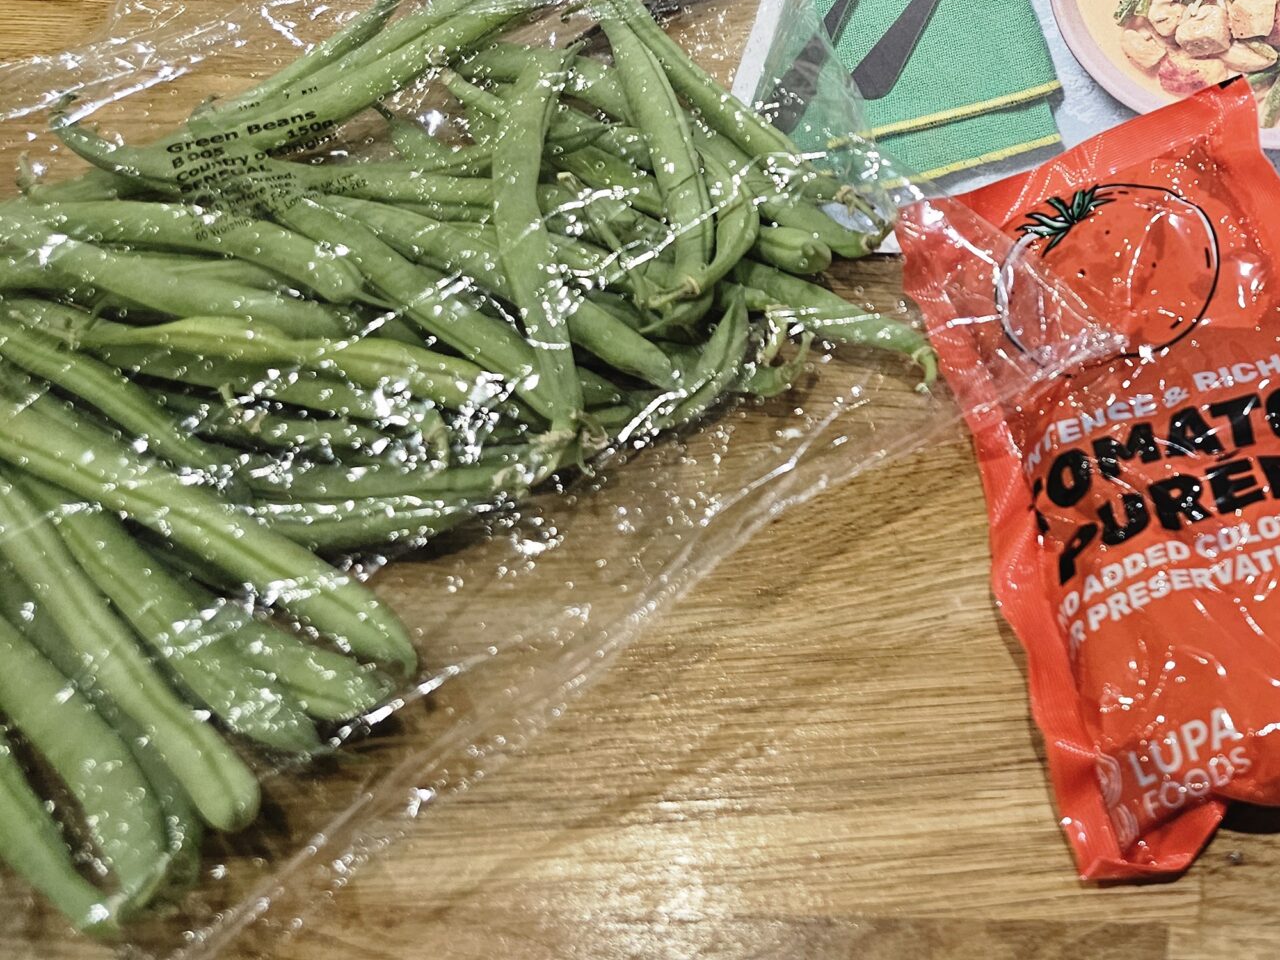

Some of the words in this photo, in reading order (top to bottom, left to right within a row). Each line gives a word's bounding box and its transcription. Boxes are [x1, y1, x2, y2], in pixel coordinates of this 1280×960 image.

[166, 129, 239, 154] Green
[246, 109, 318, 137] Beans
[176, 153, 249, 183] Country
[179, 163, 273, 193] SENEGAL
[1023, 394, 1158, 477] NTENSE
[1083, 540, 1192, 601] ADDED
[1128, 706, 1244, 788] LUPA
[1143, 745, 1252, 819] FOODS
